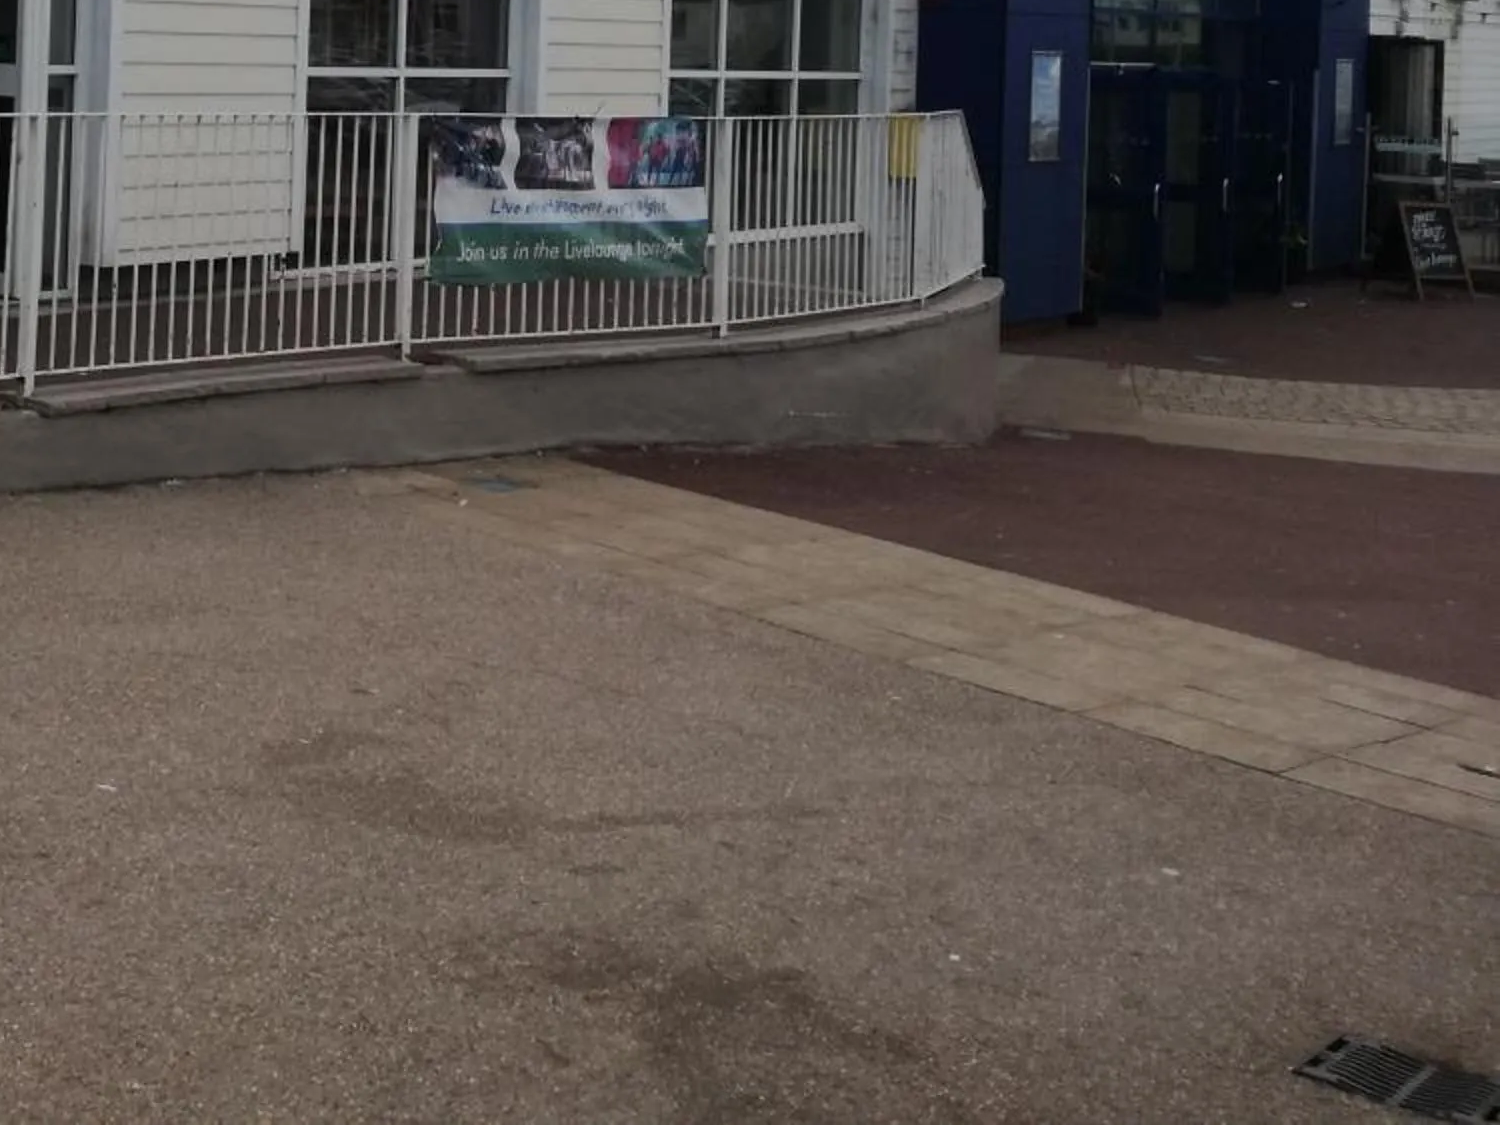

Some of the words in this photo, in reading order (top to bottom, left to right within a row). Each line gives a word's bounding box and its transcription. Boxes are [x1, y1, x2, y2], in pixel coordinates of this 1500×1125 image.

[456, 239, 485, 262] Join
[489, 245, 508, 260] us
[513, 240, 529, 260] in
[533, 238, 560, 260] the
